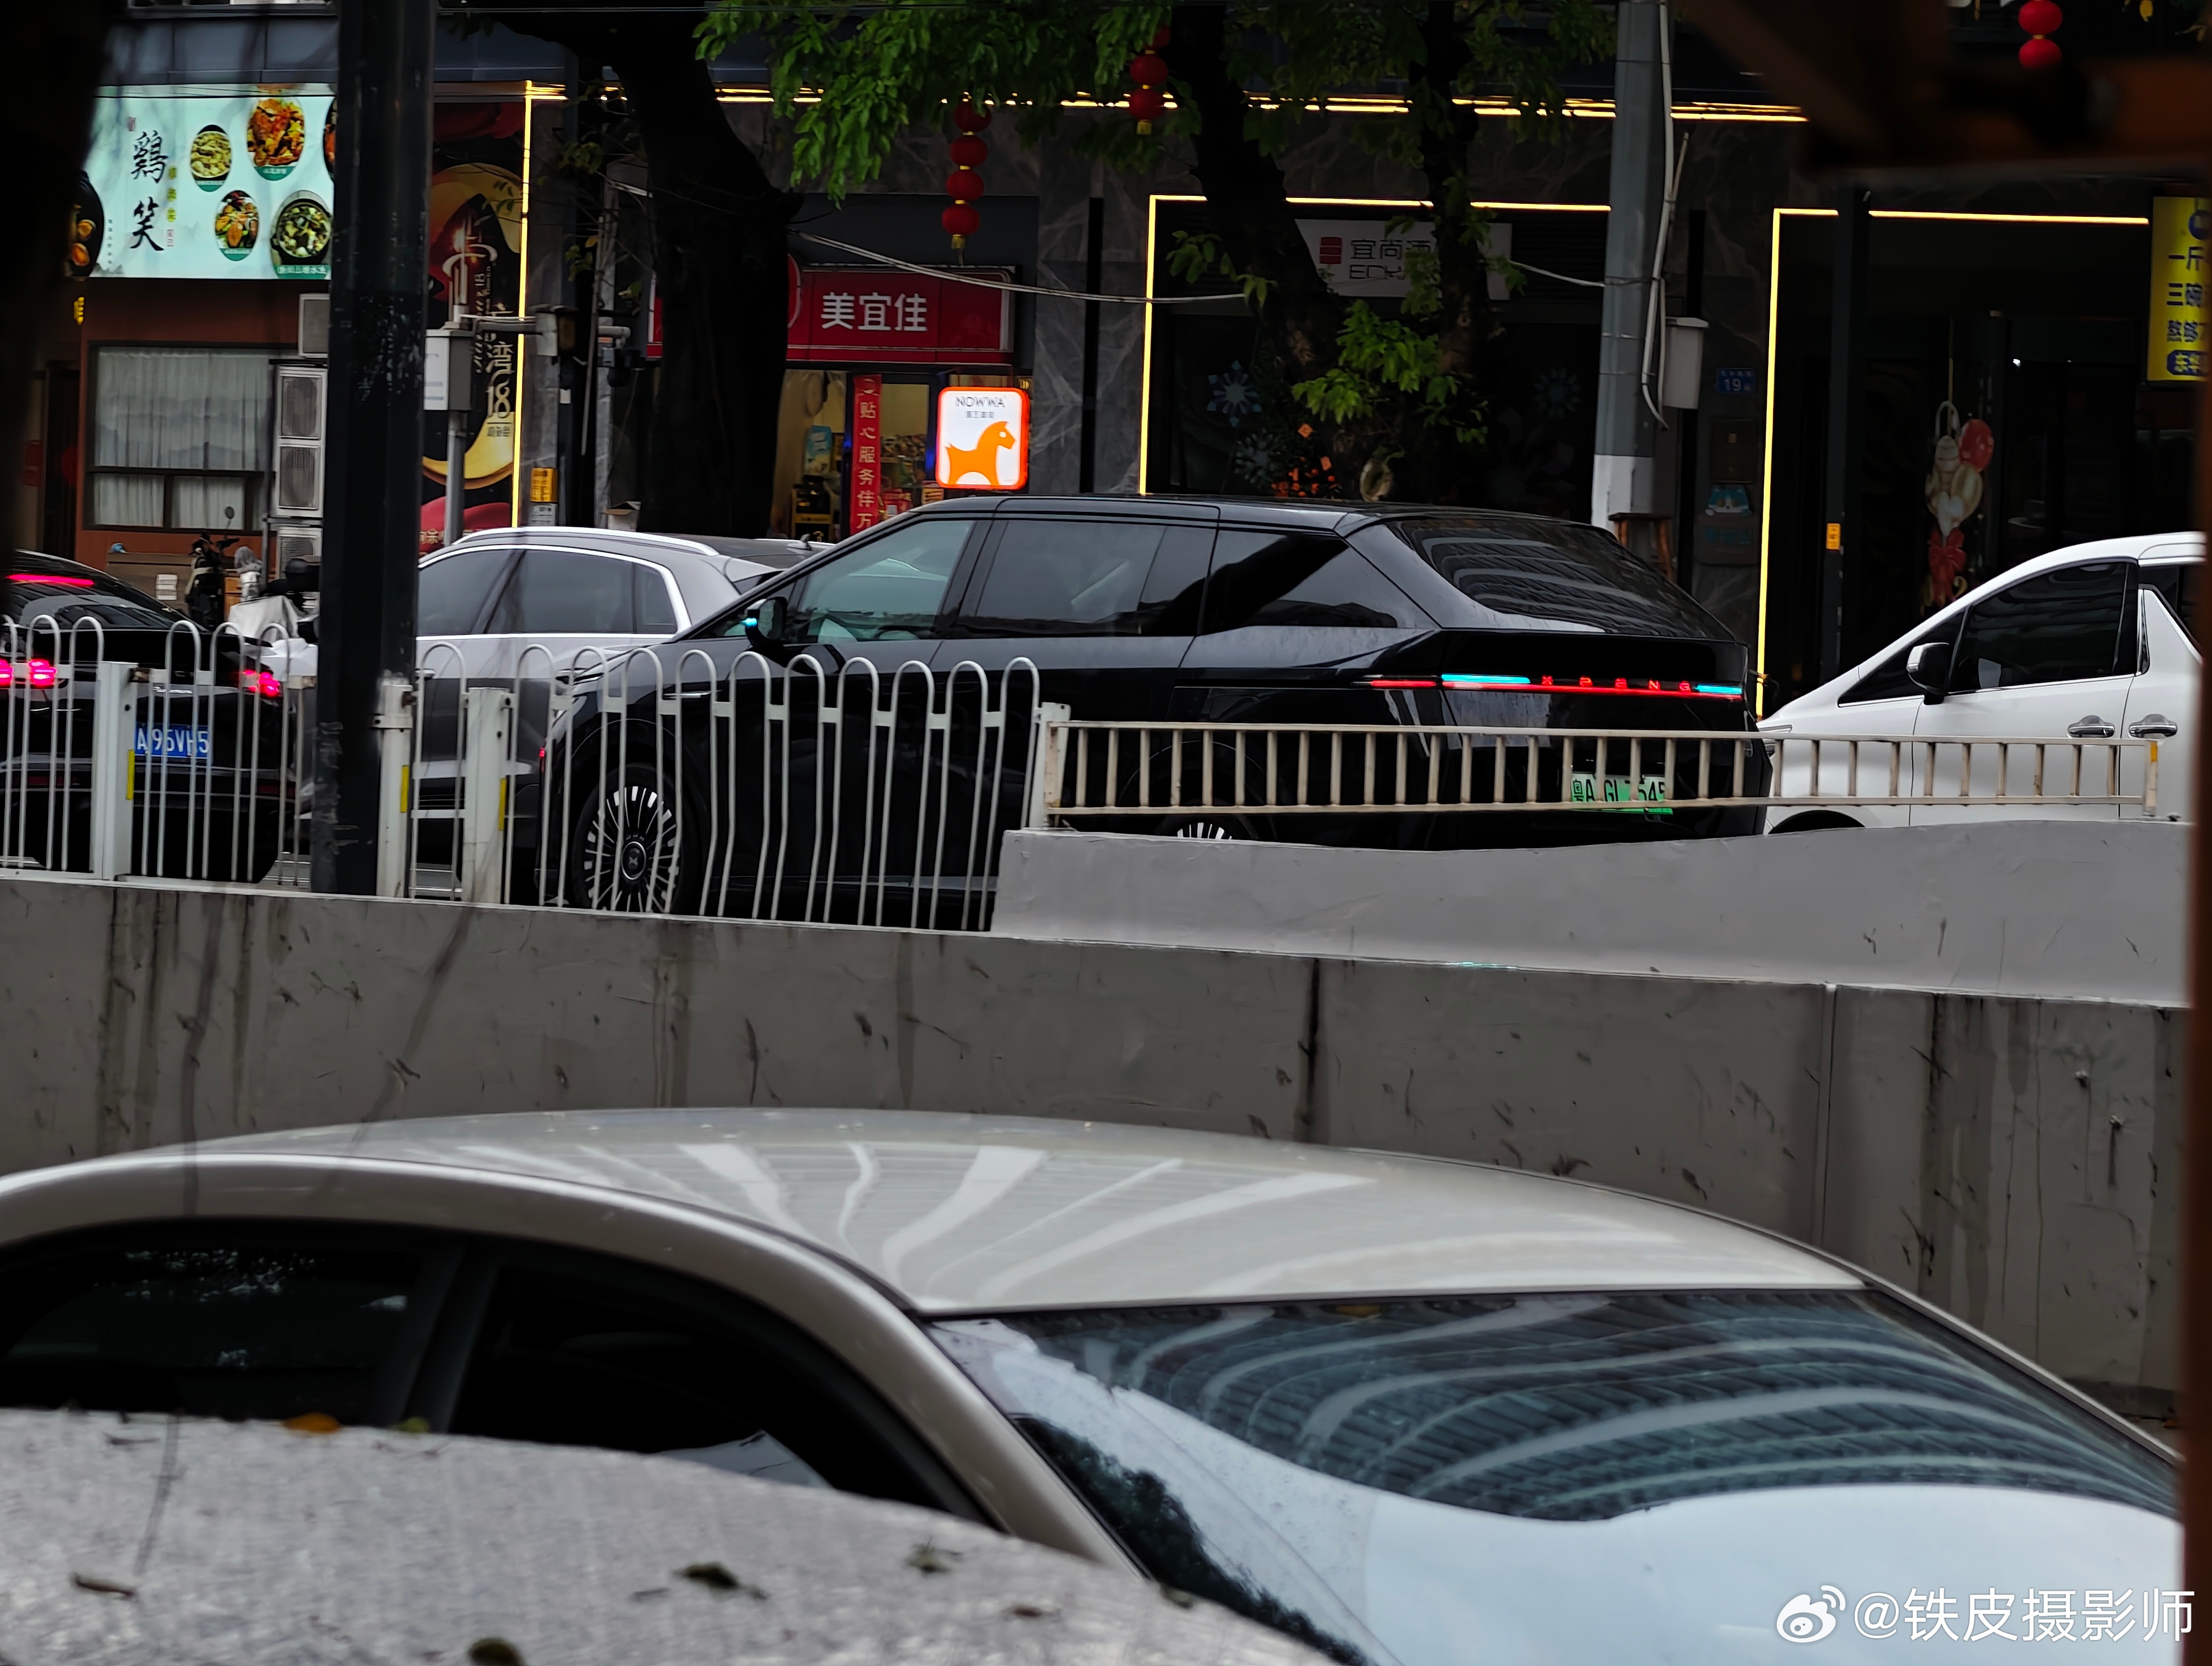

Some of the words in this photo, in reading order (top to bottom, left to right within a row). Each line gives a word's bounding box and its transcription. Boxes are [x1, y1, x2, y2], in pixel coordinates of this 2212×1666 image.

[820, 291, 928, 332] 美宜佳
[956, 396, 1006, 407] NOWWA
